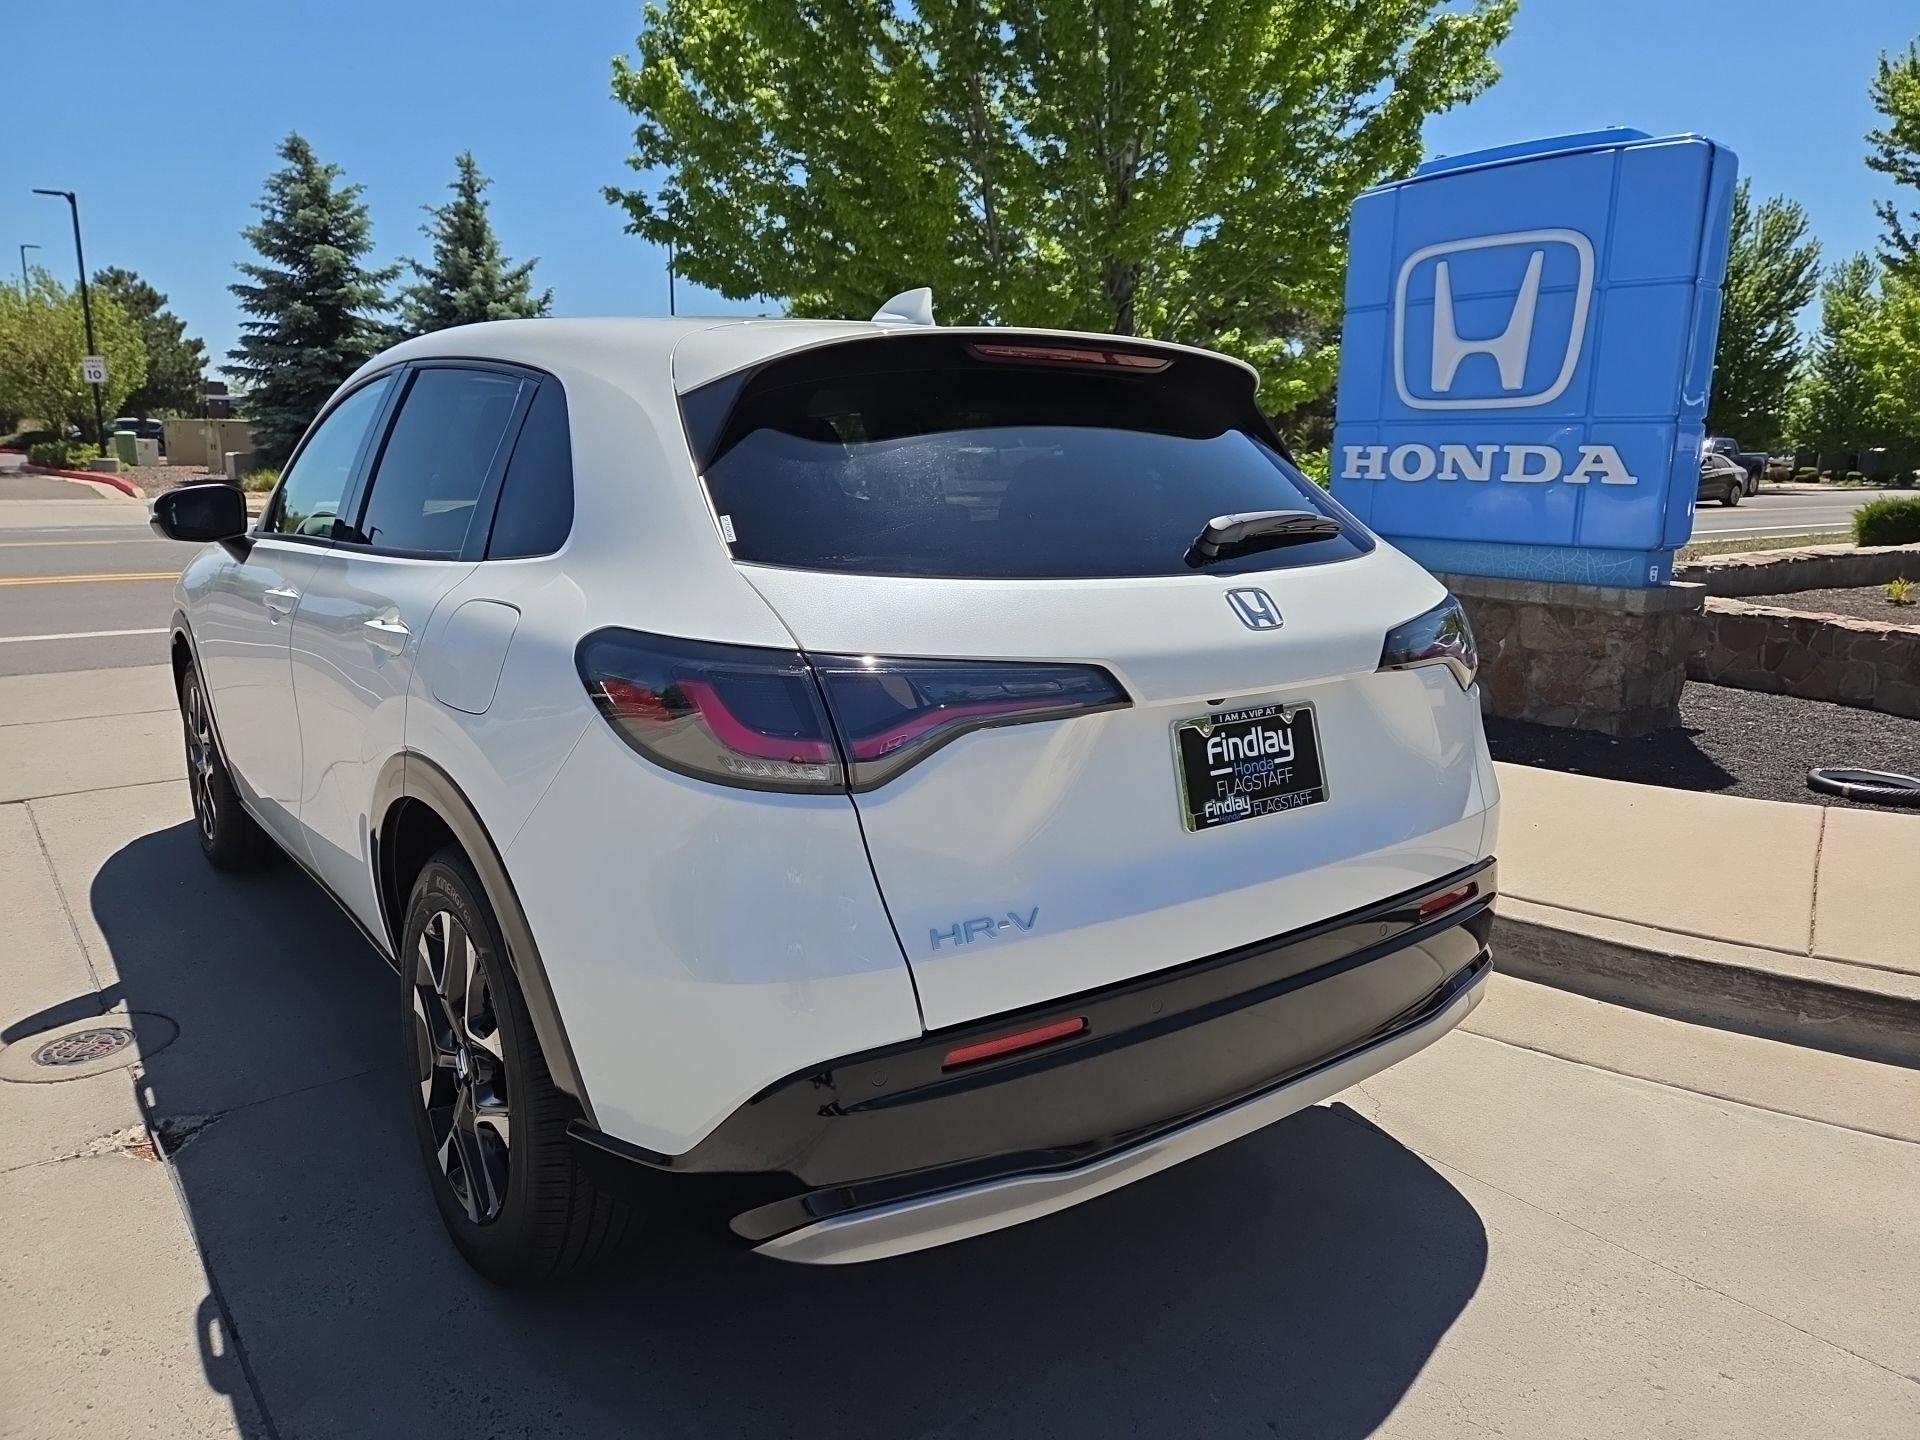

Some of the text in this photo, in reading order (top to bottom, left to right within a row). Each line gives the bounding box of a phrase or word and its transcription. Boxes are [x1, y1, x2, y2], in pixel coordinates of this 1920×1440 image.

[87, 370, 102, 379] 10
[1340, 443, 1638, 485] HONDA
[1224, 713, 1239, 722] AM
[1248, 709, 1263, 718] VIP
[1265, 707, 1276, 715] AT
[1207, 726, 1295, 765] Findlay
[1233, 756, 1275, 776] Honda
[1216, 766, 1294, 798] FLAGSTAFF
[1253, 790, 1313, 816] FLAGSTAFF
[928, 905, 1040, 951] HR-V
